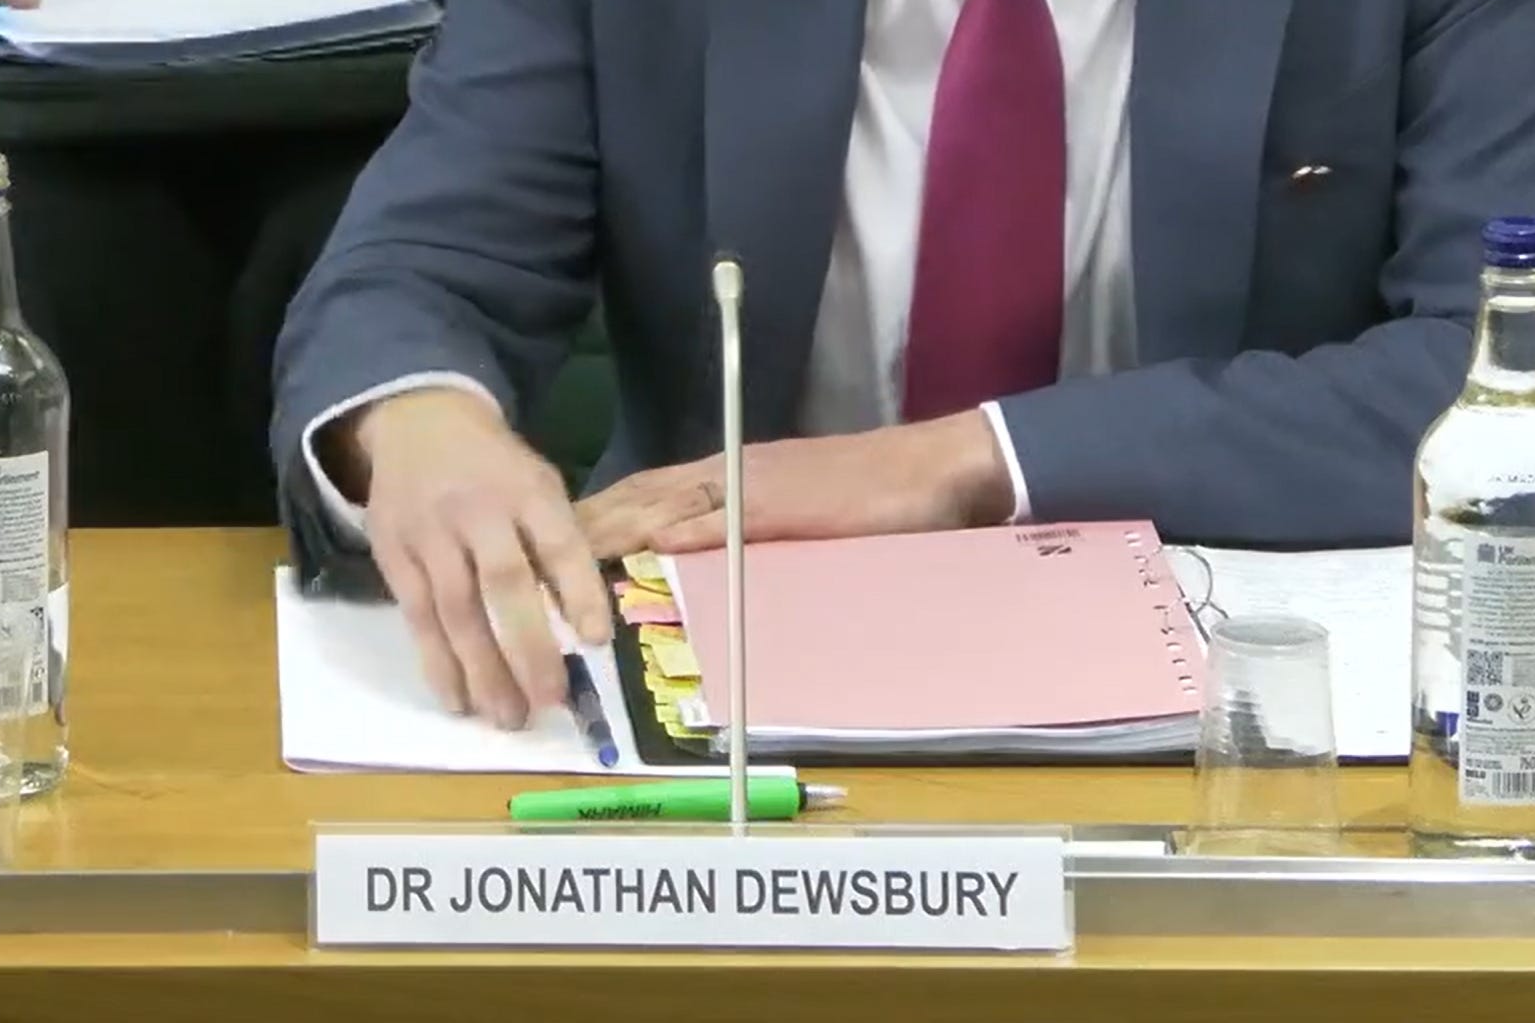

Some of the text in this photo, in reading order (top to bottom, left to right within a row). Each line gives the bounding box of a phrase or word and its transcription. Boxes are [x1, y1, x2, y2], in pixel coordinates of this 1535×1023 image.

[367, 866, 1019, 917] DR JONATHAN DEWSBURY
